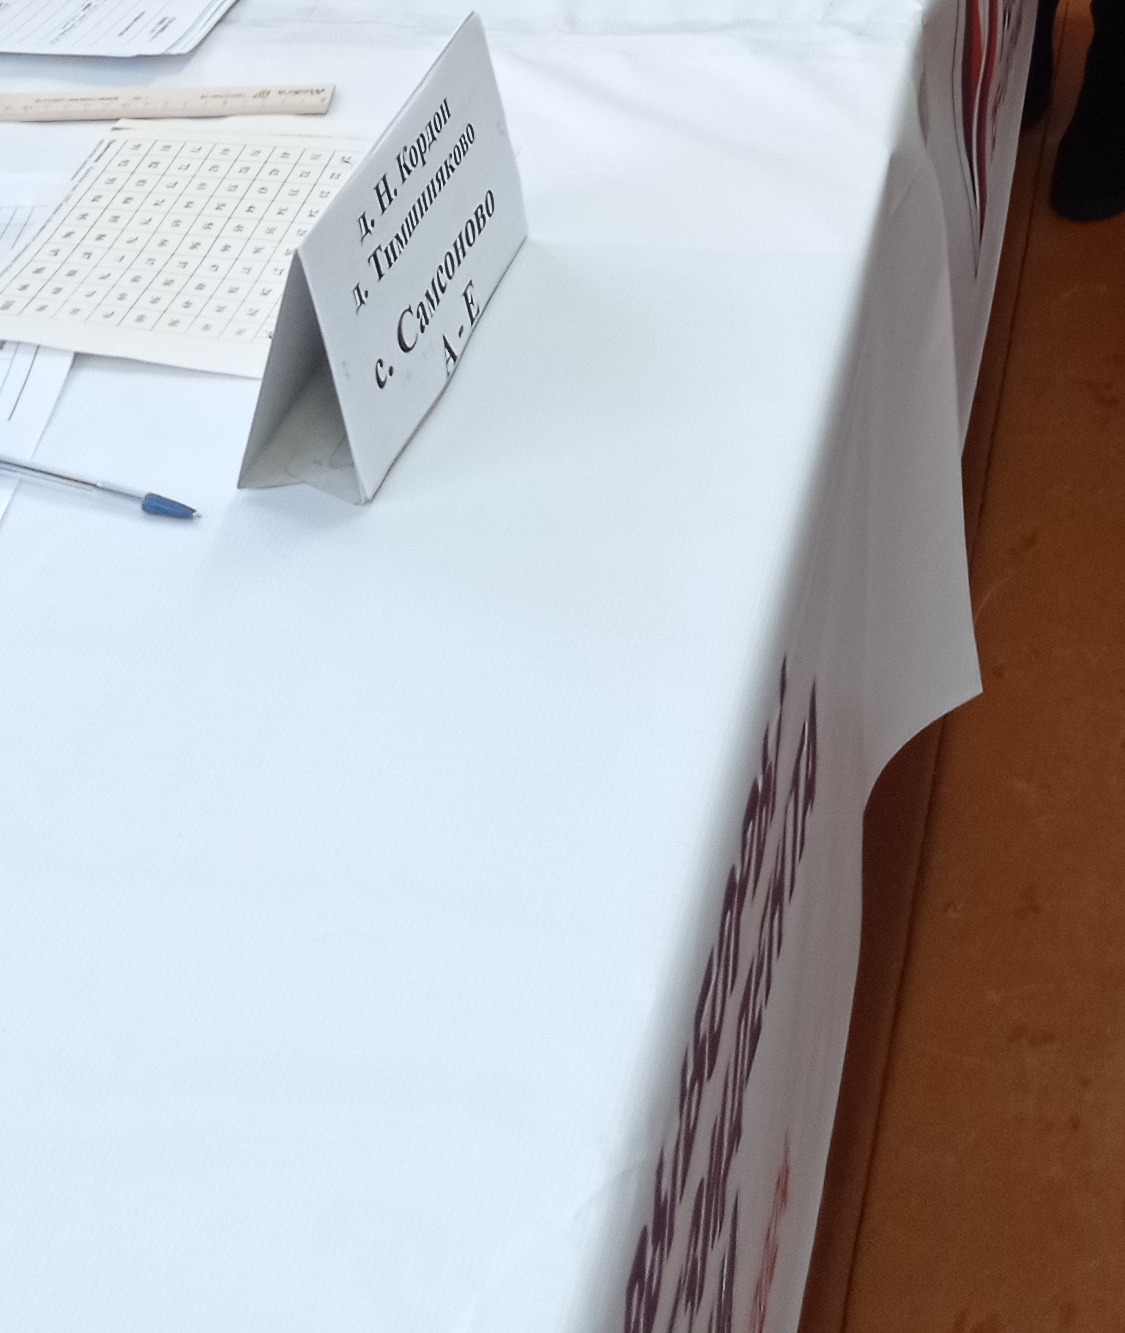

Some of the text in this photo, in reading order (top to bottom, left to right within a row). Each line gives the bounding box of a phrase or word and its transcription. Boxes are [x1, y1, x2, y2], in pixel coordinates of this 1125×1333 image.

[353, 122, 475, 314] д. Тимшиняково
[358, 97, 452, 243] д. Н. Кордон
[375, 189, 495, 389] с. Самсоново
[442, 334, 458, 376] А
[462, 280, 480, 327] Е
[668, 674, 817, 1333] ЗИДЕНТА
